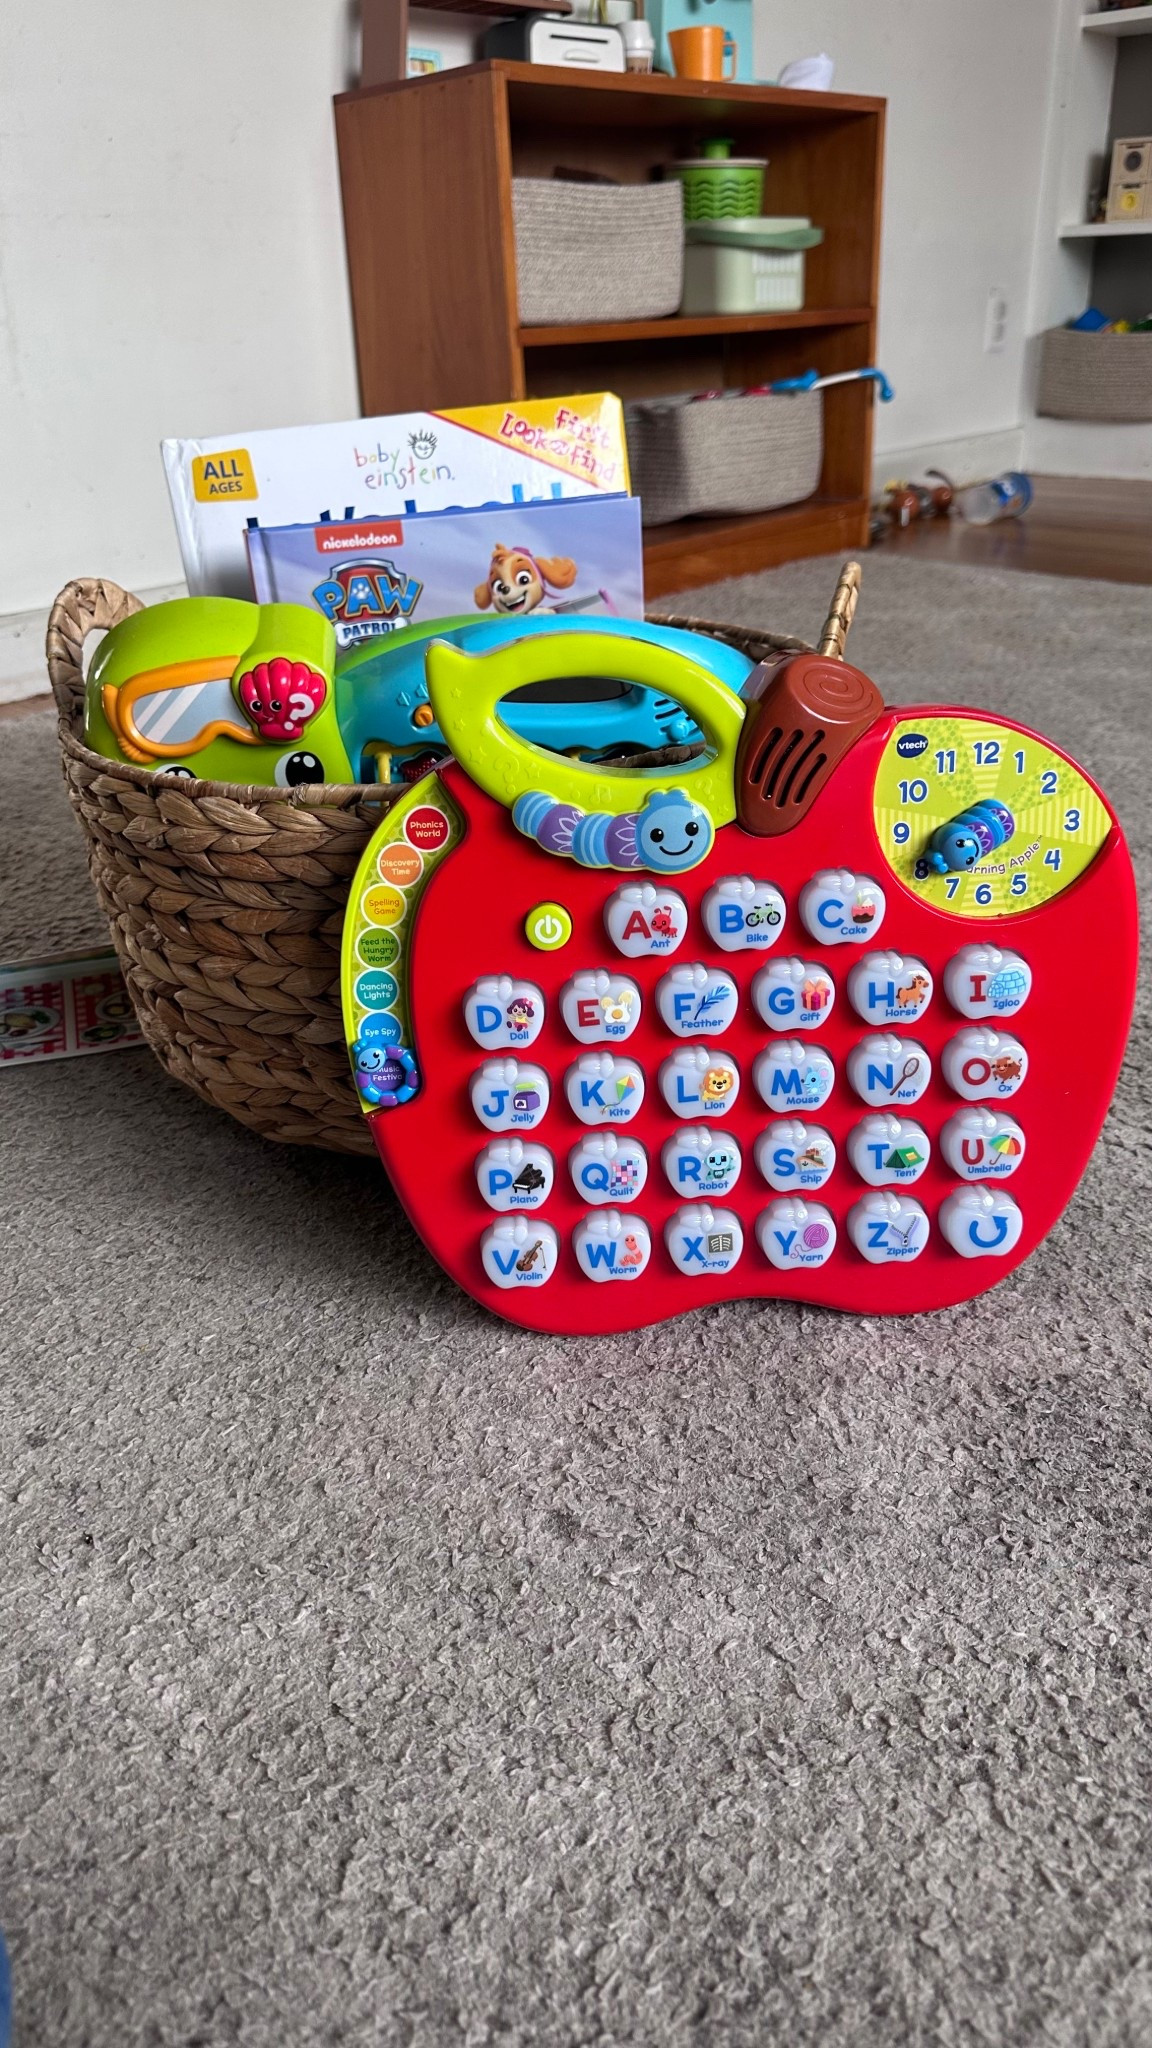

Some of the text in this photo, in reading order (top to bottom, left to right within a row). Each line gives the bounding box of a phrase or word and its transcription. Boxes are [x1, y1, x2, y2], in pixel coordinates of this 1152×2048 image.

[353, 442, 400, 472] baby
[203, 458, 244, 480] ALL
[209, 480, 243, 495] AGES
[322, 532, 398, 550] nickelodeon
[311, 575, 422, 622] PAW
[284, 693, 315, 731] ?
[935, 750, 956, 774] 11
[973, 741, 1000, 765] 12
[1014, 751, 1024, 773] 1
[899, 780, 928, 803] 10
[1041, 771, 1057, 794] 2
[410, 821, 444, 829] Phonics
[1064, 809, 1080, 831] 3
[415, 830, 441, 838] World
[893, 822, 910, 844] 9
[380, 859, 420, 868] Discovery
[914, 858, 929, 879] 8
[1044, 849, 1061, 871] 4
[391, 867, 411, 875] Time
[945, 878, 960, 898] 7
[975, 884, 992, 904] 6
[1010, 874, 1027, 895] 5
[369, 899, 400, 908] Spelling
[818, 899, 844, 928] C
[622, 911, 652, 941] A
[719, 904, 744, 933] B
[746, 934, 769, 943] Bike
[840, 925, 867, 936] Cake
[360, 937, 395, 946] Feed the
[363, 947, 394, 955] Hungry
[650, 938, 671, 949] Ant
[360, 983, 393, 991] Dancing
[363, 991, 391, 1001] Lights
[868, 982, 894, 1008] H
[969, 975, 986, 1002] I
[673, 993, 695, 1020] F
[768, 987, 795, 1015] G
[993, 998, 1020, 1010] Igloo
[476, 1005, 502, 1033] D
[576, 999, 600, 1027] E
[800, 1012, 821, 1022] Gift
[885, 1008, 918, 1017] Horse
[365, 1027, 396, 1037] Eye Spy
[605, 1025, 626, 1035] Egg
[681, 1018, 724, 1029] Feather
[510, 1031, 529, 1041] Doll
[867, 1064, 893, 1090] N
[962, 1057, 991, 1086] O
[677, 1075, 699, 1103] L
[771, 1069, 801, 1096] M
[998, 1084, 1013, 1093] Ox
[482, 1090, 509, 1117] J
[580, 1080, 604, 1107] K
[786, 1096, 820, 1105] Mouse
[897, 1089, 917, 1098] Net
[609, 1107, 630, 1117] Kite
[704, 1100, 725, 1110] Lion
[511, 1113, 535, 1124] Jelly
[867, 1143, 889, 1170] T
[962, 1138, 984, 1165] U
[678, 1156, 701, 1182] R
[773, 1148, 796, 1177] S
[967, 1163, 1012, 1174] Umbrella
[489, 1169, 512, 1196] P
[581, 1163, 609, 1192] Q
[800, 1174, 822, 1185] Ship
[894, 1168, 917, 1178] Tent
[609, 1186, 634, 1197] Quilt
[698, 1181, 729, 1191] Robot
[510, 1195, 538, 1204] Piano
[773, 1230, 797, 1256] Y
[867, 1222, 889, 1248] Z
[585, 1241, 617, 1269] W
[682, 1236, 705, 1262] X
[800, 1253, 824, 1262] Yarn
[886, 1245, 919, 1257] Zipper
[492, 1249, 519, 1275] V
[609, 1265, 637, 1275] Worm
[701, 1259, 729, 1269] X-ray
[515, 1271, 544, 1281] Violin
